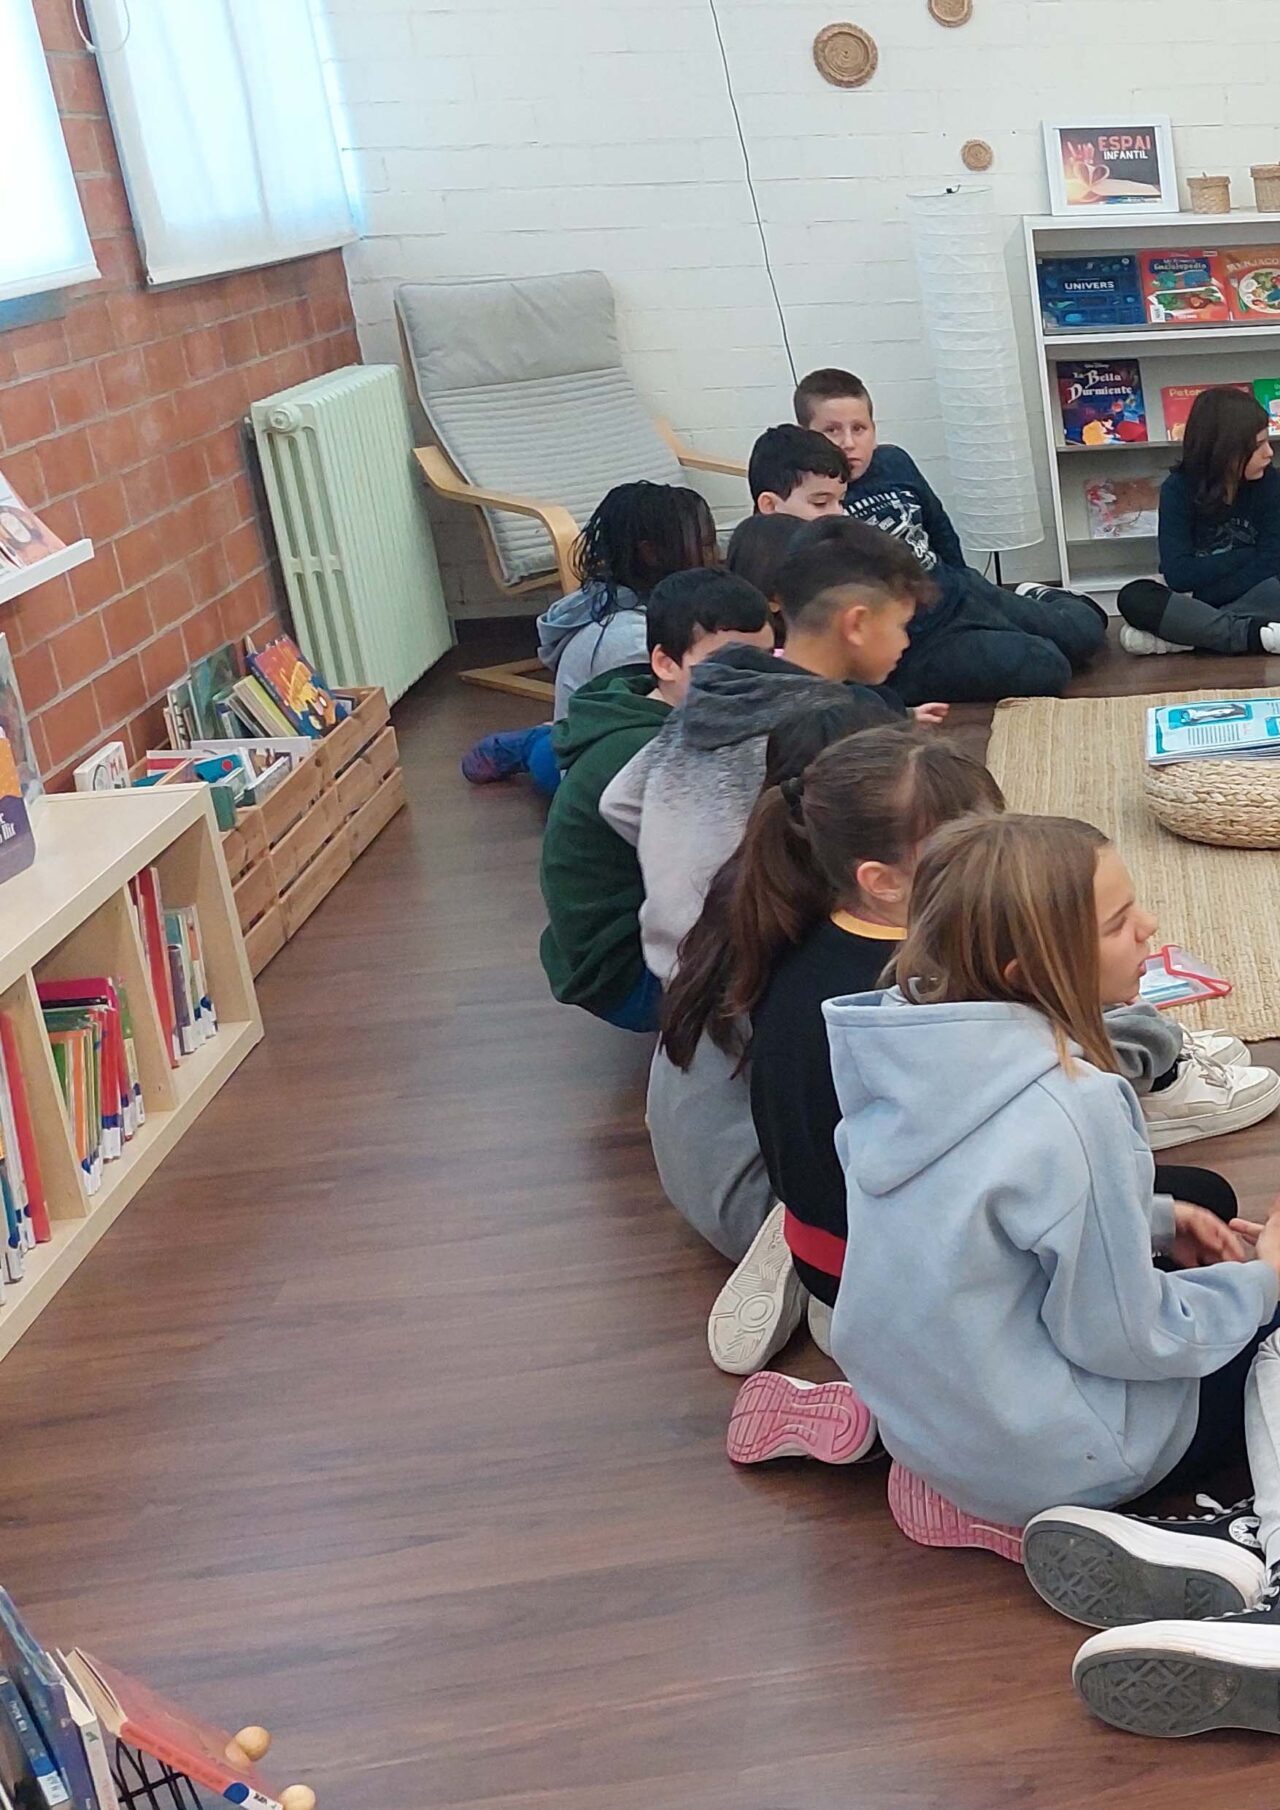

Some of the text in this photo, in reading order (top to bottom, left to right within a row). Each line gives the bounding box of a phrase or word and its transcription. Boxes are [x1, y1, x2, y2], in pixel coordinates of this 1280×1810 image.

[1098, 134, 1152, 151] ESPAI
[1103, 150, 1149, 160] INFANTIL
[1064, 281, 1115, 290] UNIVERS
[1083, 369, 1122, 389] Bella
[1066, 383, 1133, 404] Durmiente
